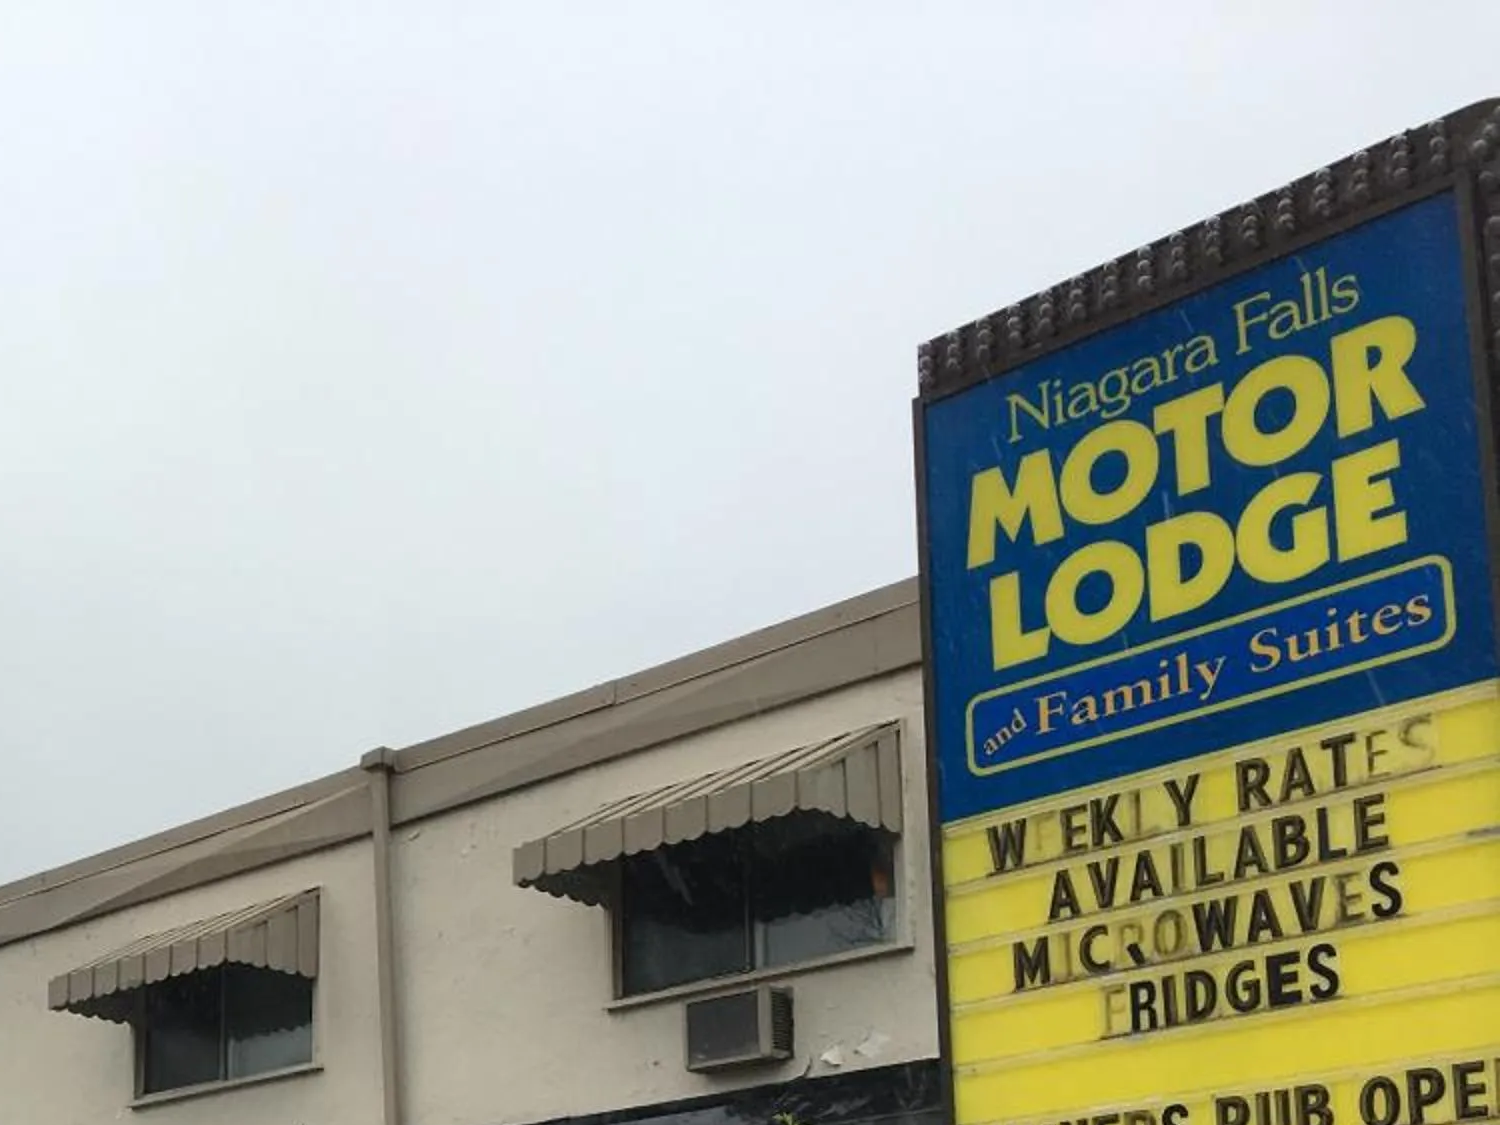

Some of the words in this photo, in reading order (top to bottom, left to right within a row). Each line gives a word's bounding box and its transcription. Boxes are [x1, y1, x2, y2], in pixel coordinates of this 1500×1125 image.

[1007, 334, 1218, 443] Niagara
[1233, 267, 1360, 355] Falls
[967, 315, 1426, 569] MOTOR
[989, 439, 1408, 671] LODGE
[983, 707, 1027, 756] and
[1035, 655, 1225, 735] Family
[1249, 594, 1433, 674] Suites
[1235, 713, 1433, 812] RATES
[1012, 861, 1403, 993] MICROWAVES
[1048, 793, 1389, 921] AVAILABLE
[1102, 943, 1340, 1034] FRIDGES
